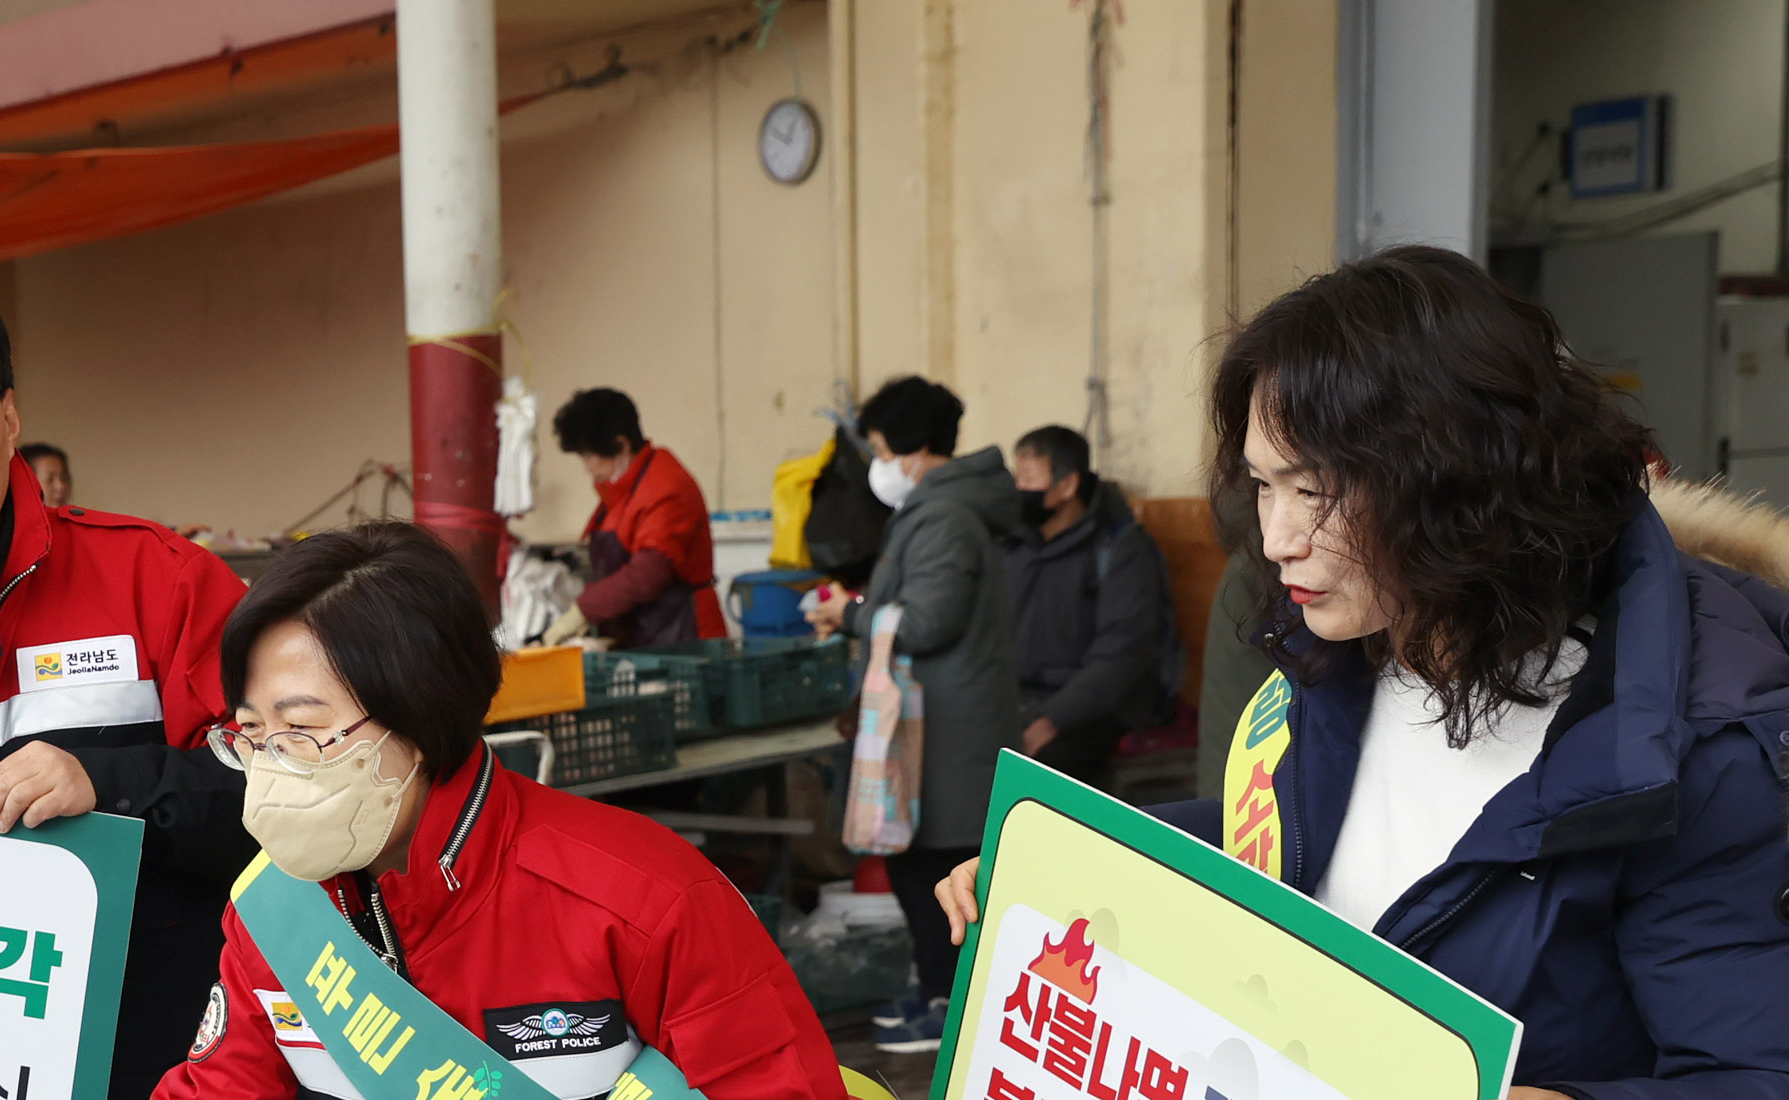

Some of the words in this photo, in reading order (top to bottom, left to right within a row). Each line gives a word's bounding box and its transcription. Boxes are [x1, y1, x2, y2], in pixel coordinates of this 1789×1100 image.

[66, 649, 119, 666] 전라남도
[306, 941, 415, 1076] 푸른
[515, 1039, 557, 1053] FOREST
[562, 1037, 601, 1048] POLICE
